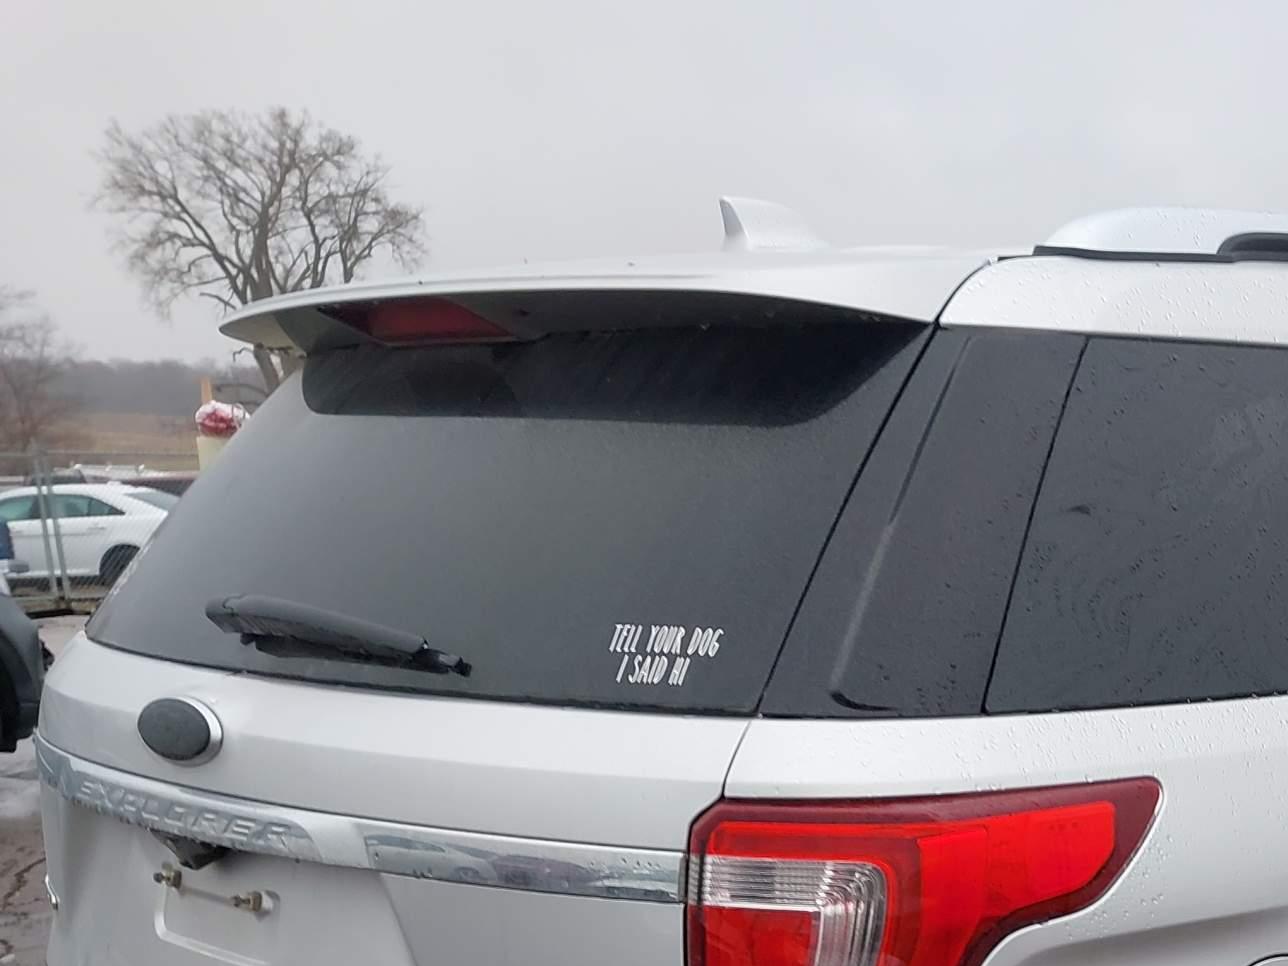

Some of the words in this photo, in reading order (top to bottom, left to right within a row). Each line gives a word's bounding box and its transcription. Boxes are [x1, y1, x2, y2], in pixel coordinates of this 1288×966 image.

[609, 624, 643, 653] TELL
[646, 624, 686, 655] YOUR
[687, 627, 724, 657] DOG
[615, 654, 629, 683] I
[628, 654, 669, 685] SAID
[668, 656, 691, 686] HI
[78, 780, 289, 846] EXPLORER
